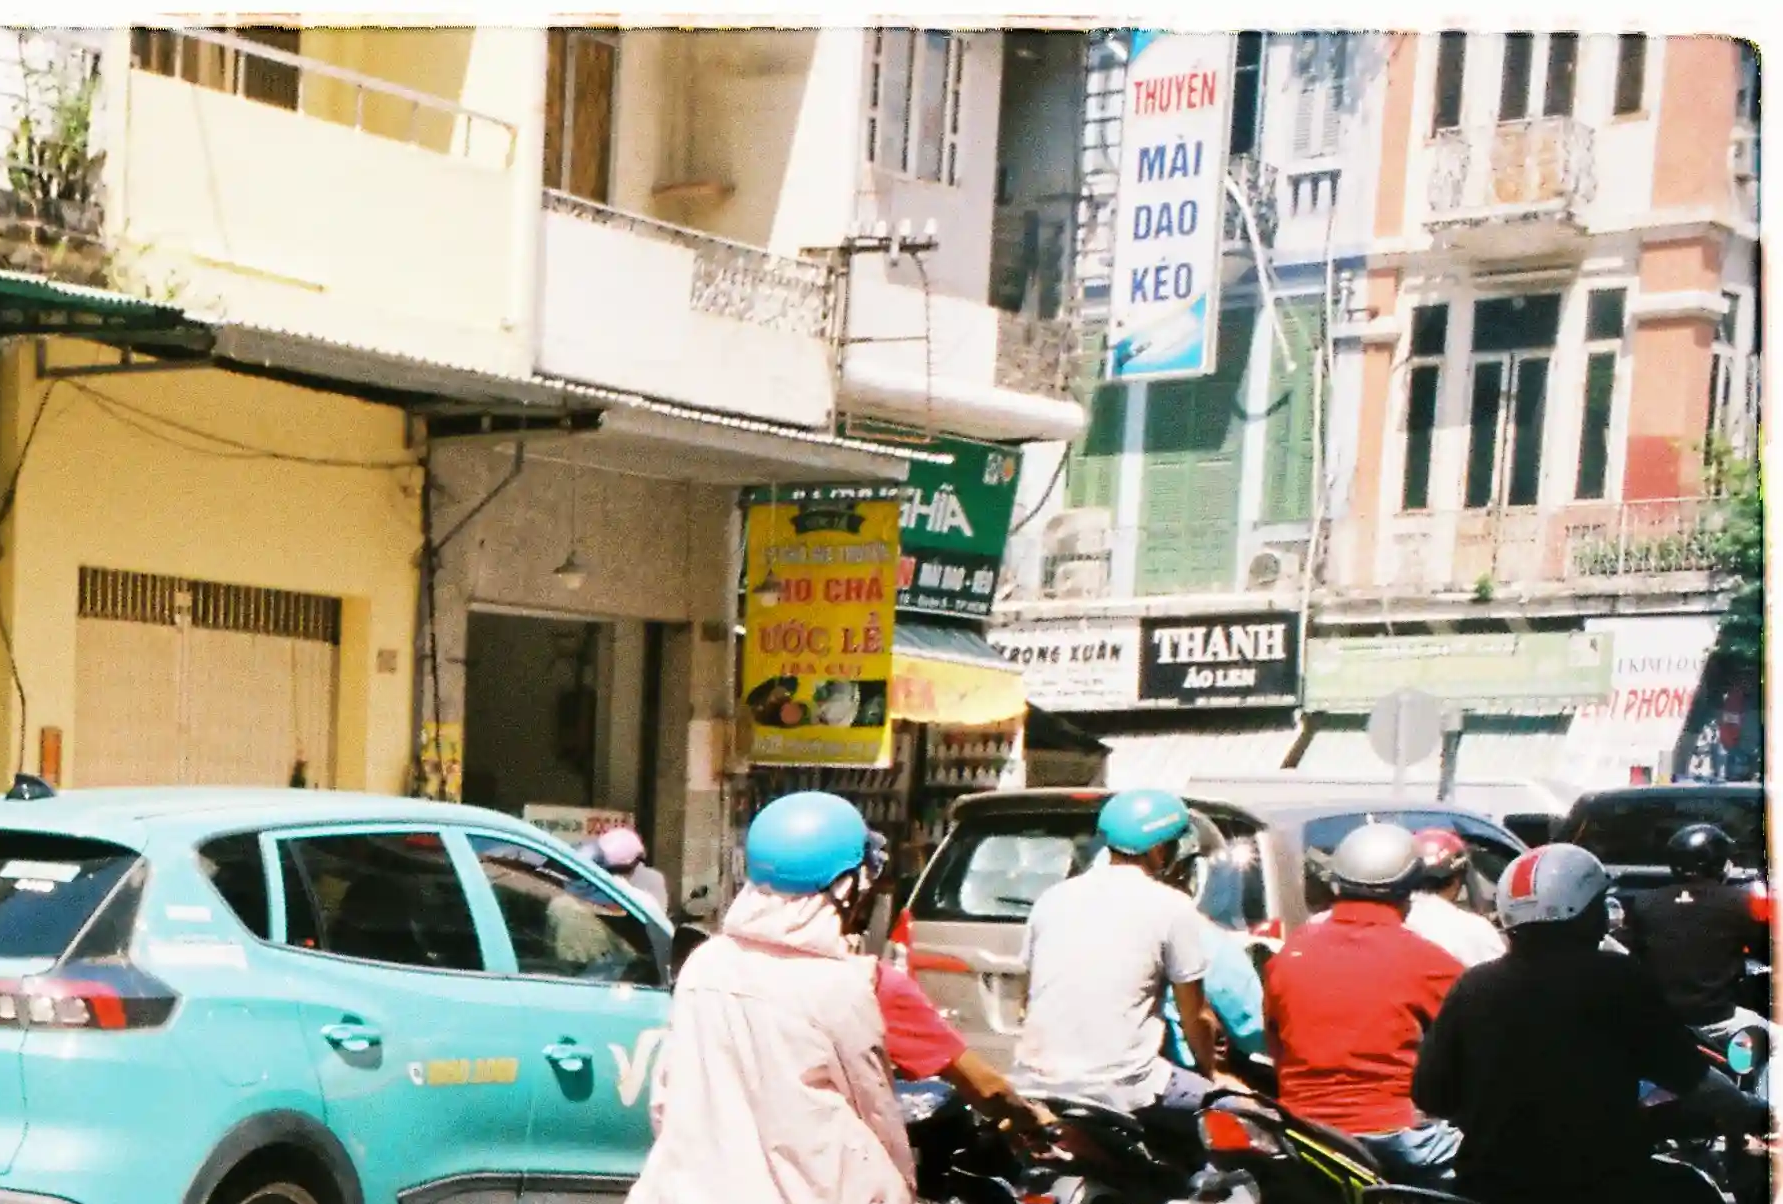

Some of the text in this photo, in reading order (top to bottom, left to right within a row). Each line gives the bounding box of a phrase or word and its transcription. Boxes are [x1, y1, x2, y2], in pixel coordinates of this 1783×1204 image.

[1137, 133, 1203, 184] MÀI
[1133, 200, 1199, 240] DAO
[1130, 256, 1193, 305] KÉO
[1153, 623, 1287, 664] THANH
